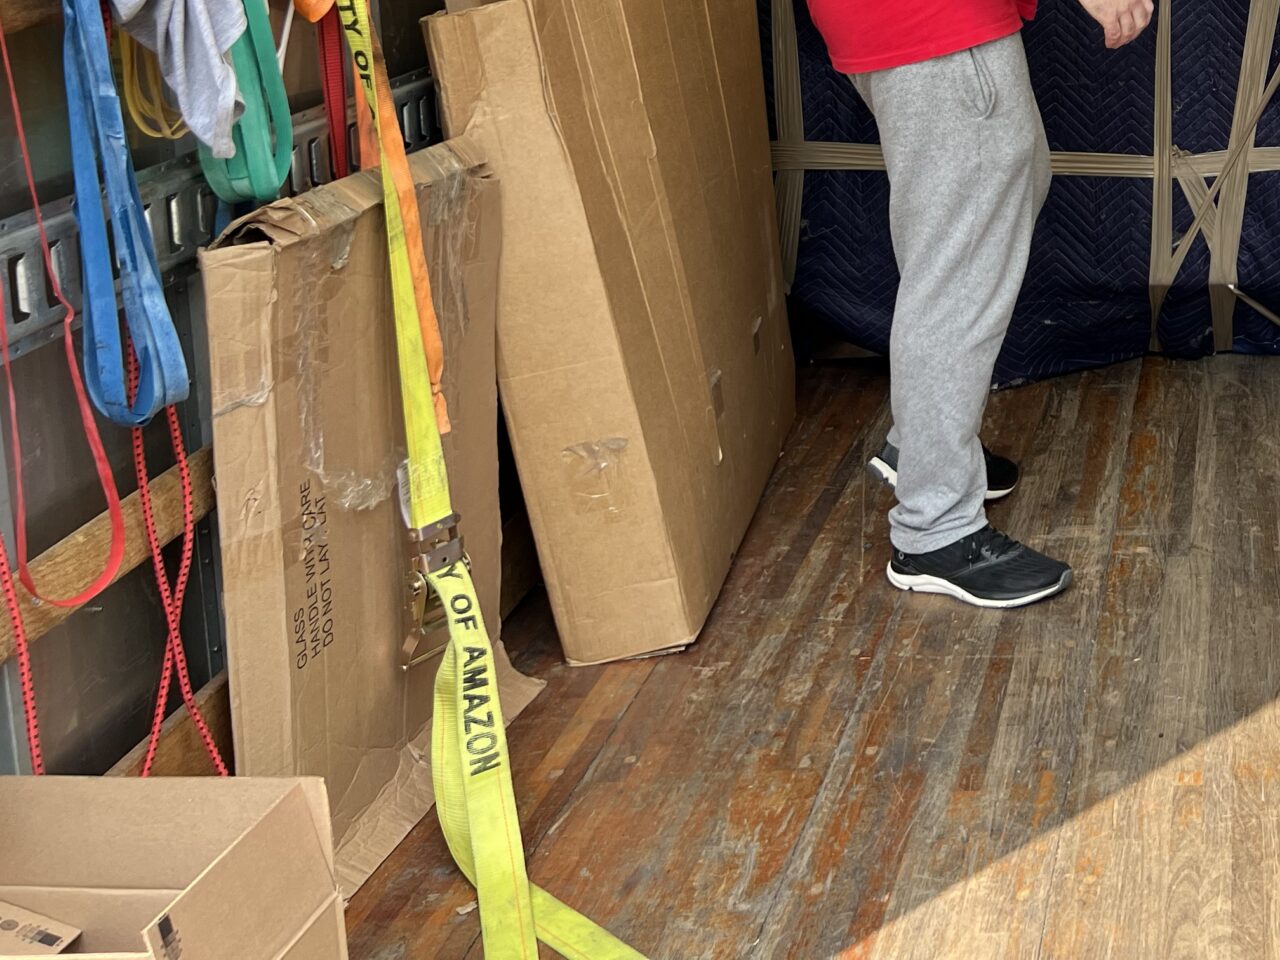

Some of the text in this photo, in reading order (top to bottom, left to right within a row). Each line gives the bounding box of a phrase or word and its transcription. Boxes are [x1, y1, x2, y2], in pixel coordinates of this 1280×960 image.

[354, 50, 373, 91] OF
[299, 478, 317, 532] CARE
[314, 495, 335, 648] DO NOT LAY LAT
[293, 607, 308, 669] GLASS
[306, 582, 322, 659] HANDLE
[449, 593, 478, 631] OF
[462, 646, 501, 777] AMAZON
